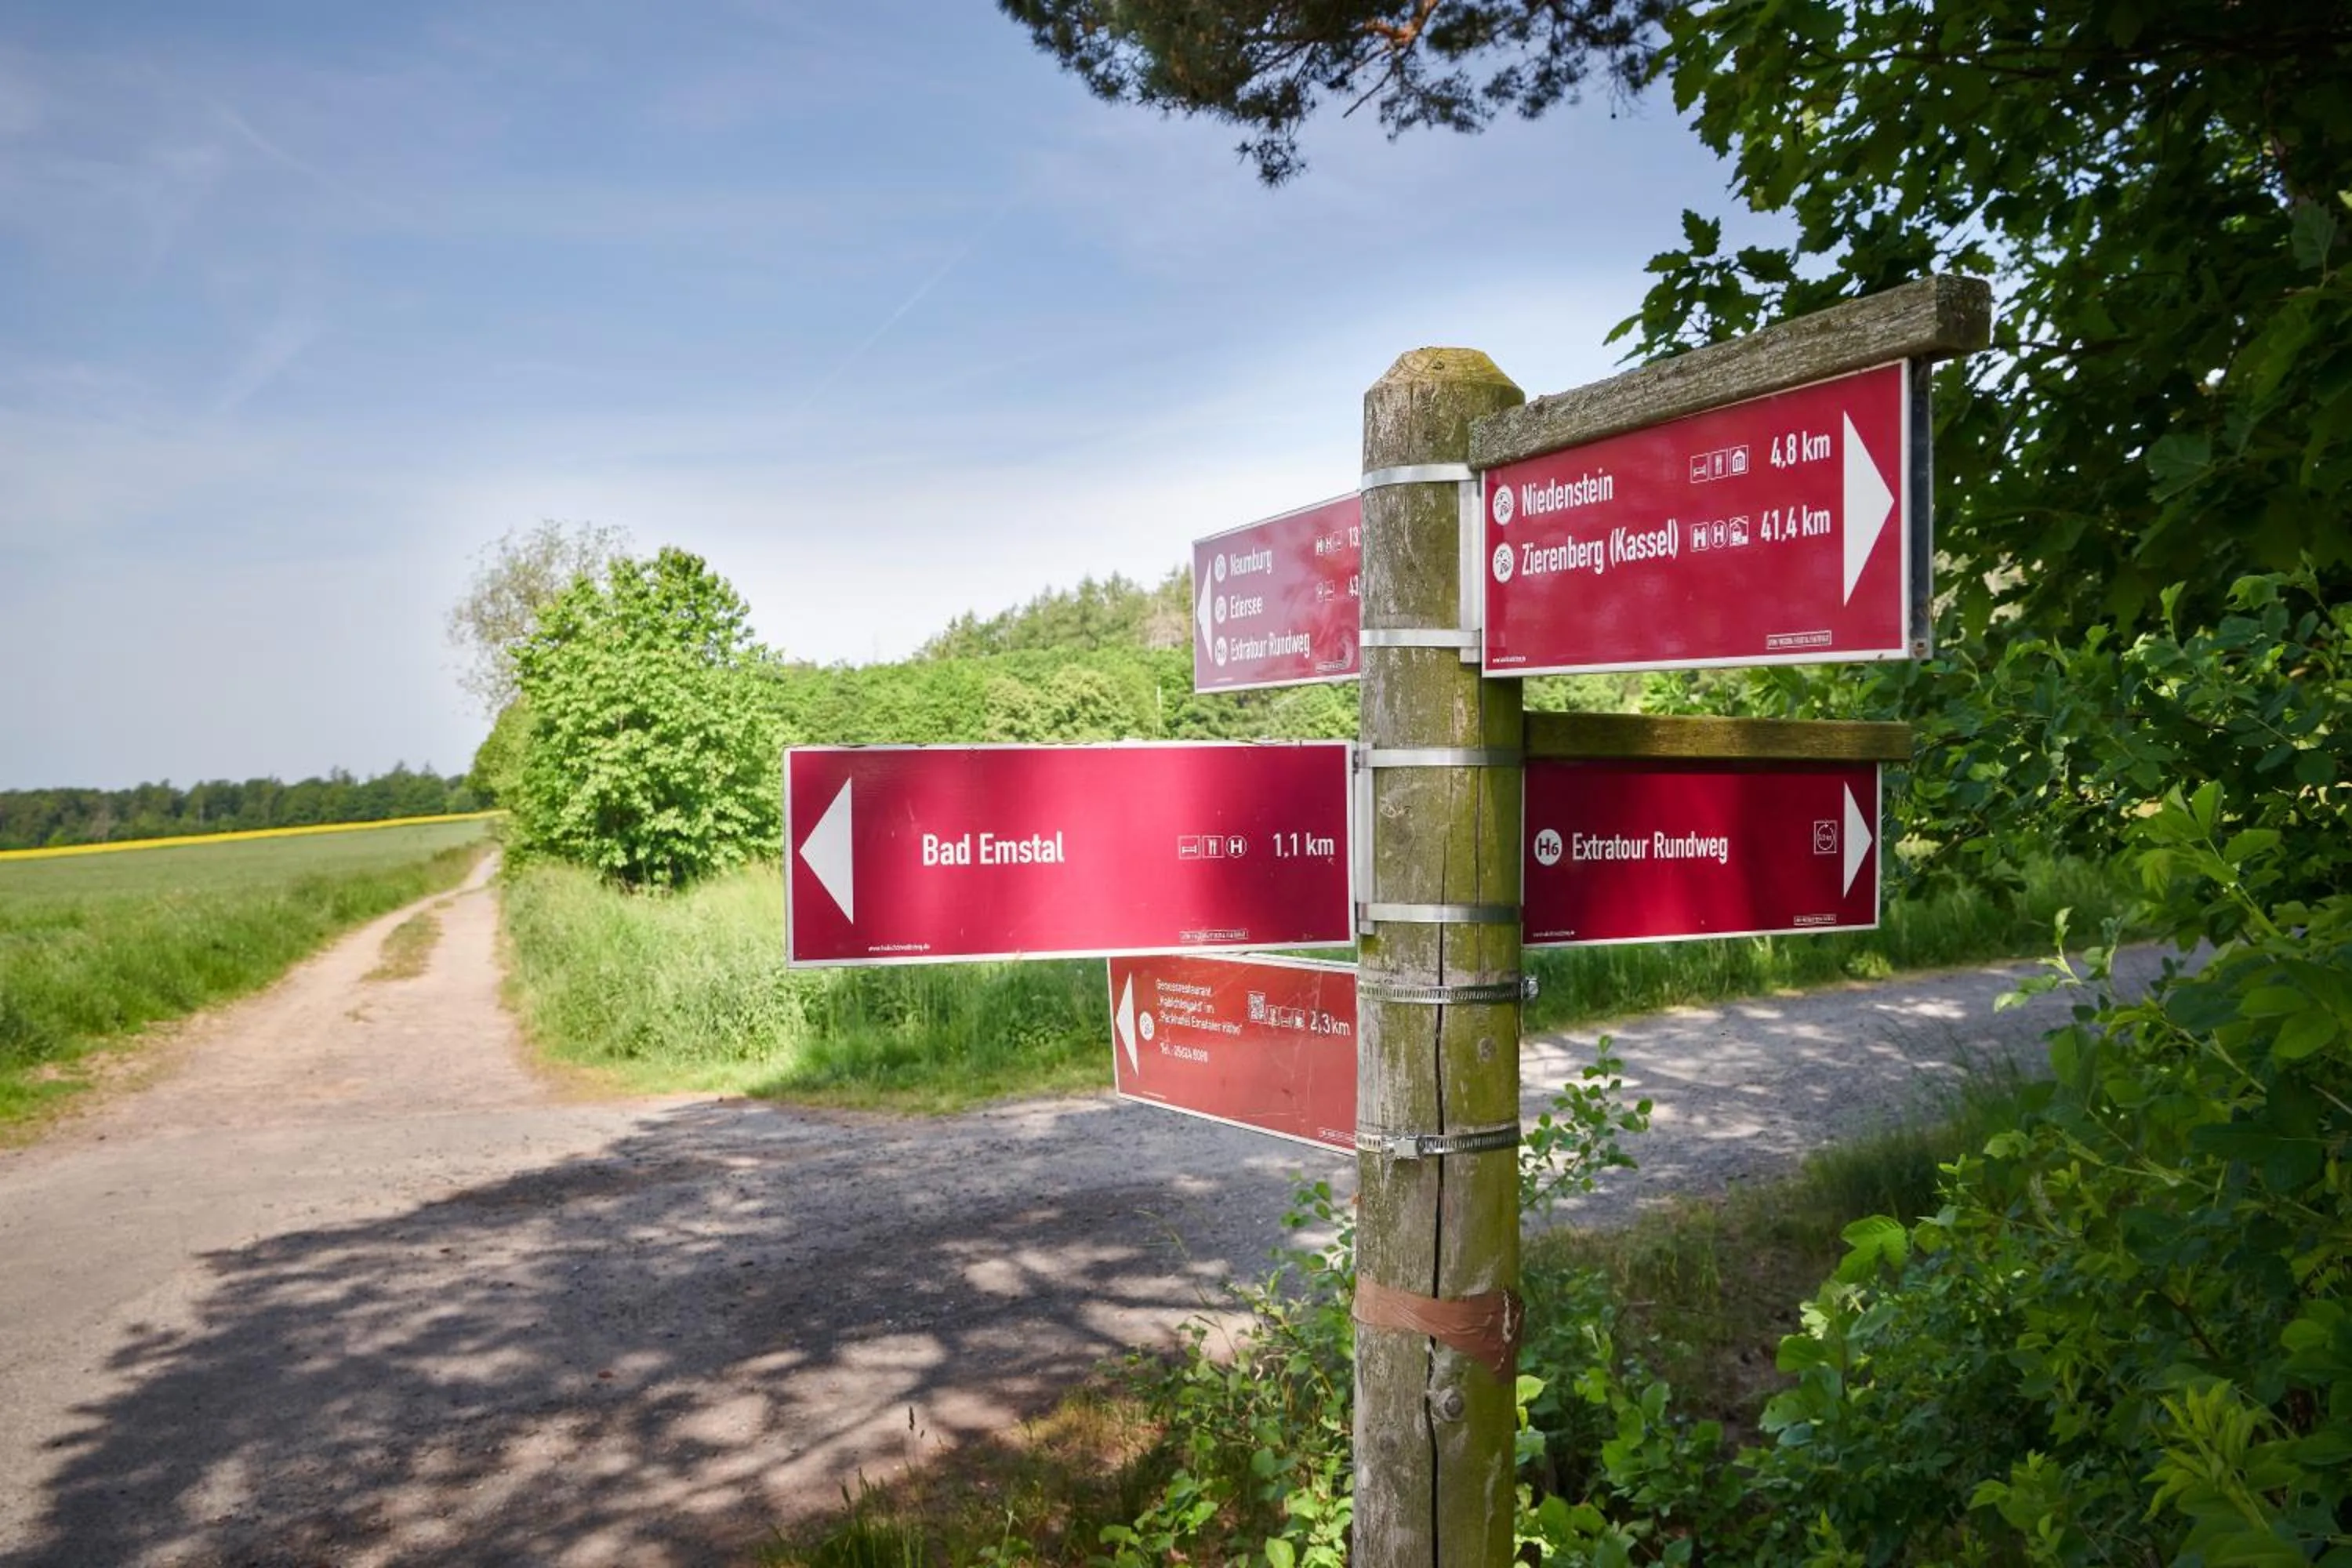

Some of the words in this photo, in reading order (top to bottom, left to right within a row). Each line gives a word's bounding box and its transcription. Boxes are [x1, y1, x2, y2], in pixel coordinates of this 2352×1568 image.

[1521, 467, 1613, 517] Niedenstein
[1770, 433, 1797, 469] 4,8
[1802, 430, 1831, 463] km
[1521, 535, 1604, 575] Zierenberg
[1610, 518, 1679, 568] (Kassel)
[1760, 506, 1798, 542] 41,4
[1802, 504, 1831, 536] km
[1229, 546, 1272, 576] Naumburg
[1229, 594, 1263, 619] Edersee
[1229, 635, 1268, 662] Extratour
[1269, 628, 1311, 659] Rundweg
[923, 833, 971, 866] Bad
[978, 830, 1065, 864] Emstal
[1272, 832, 1298, 858] 1,1
[1305, 832, 1335, 856] km
[1537, 837, 1560, 857] H6
[1573, 833, 1650, 861] Extratour
[1653, 831, 1729, 865] Rundweg
[1309, 1010, 1330, 1034] 2,3
[1330, 1015, 1351, 1036] km
